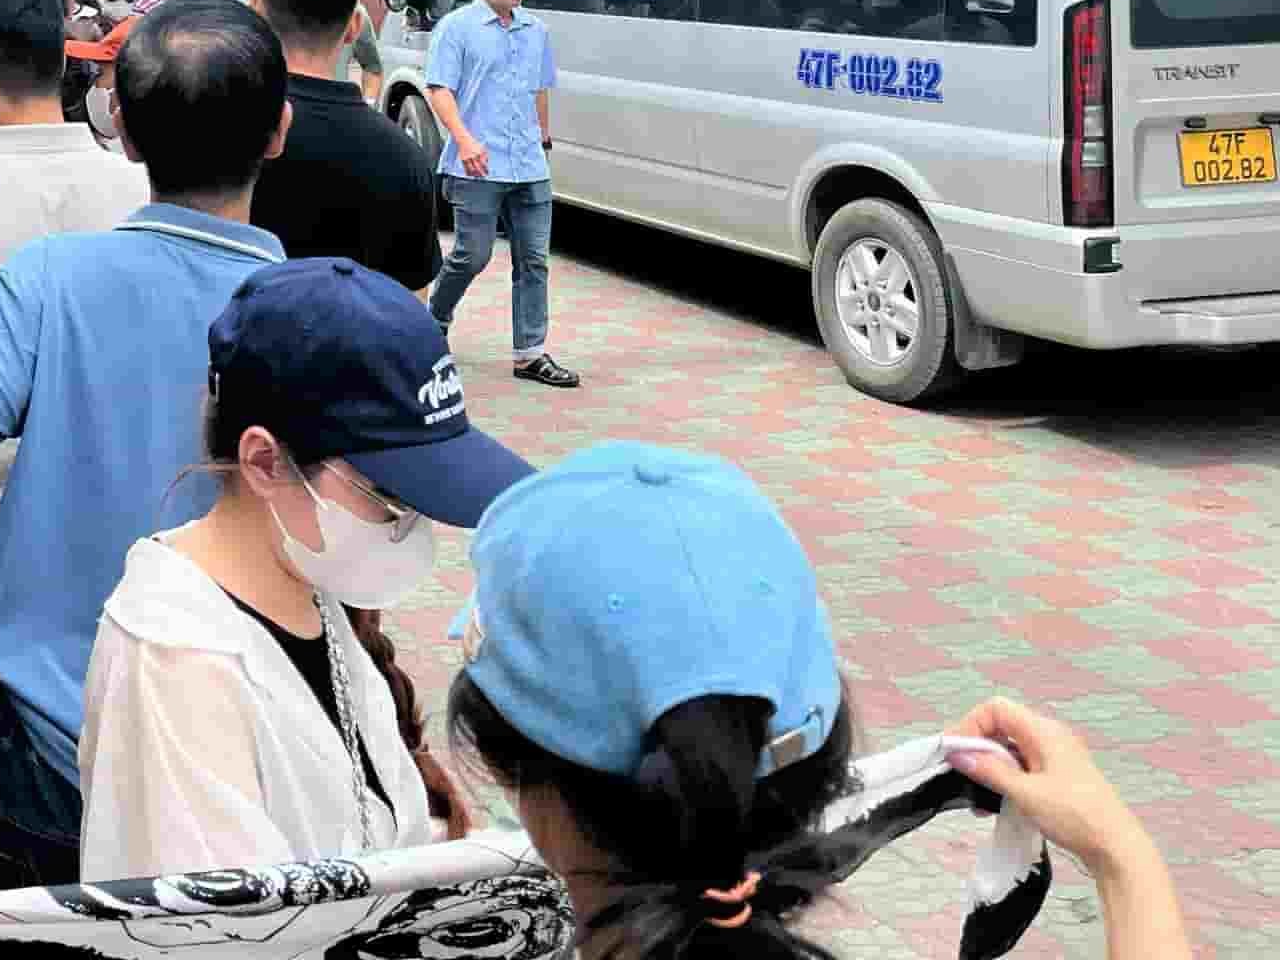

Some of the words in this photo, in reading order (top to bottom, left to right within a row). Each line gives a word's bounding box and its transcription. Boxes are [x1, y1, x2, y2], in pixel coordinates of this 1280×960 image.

[1152, 64, 1240, 81] TRANSIT
[1208, 132, 1247, 155] 47F
[1193, 157, 1267, 183] 002.82
